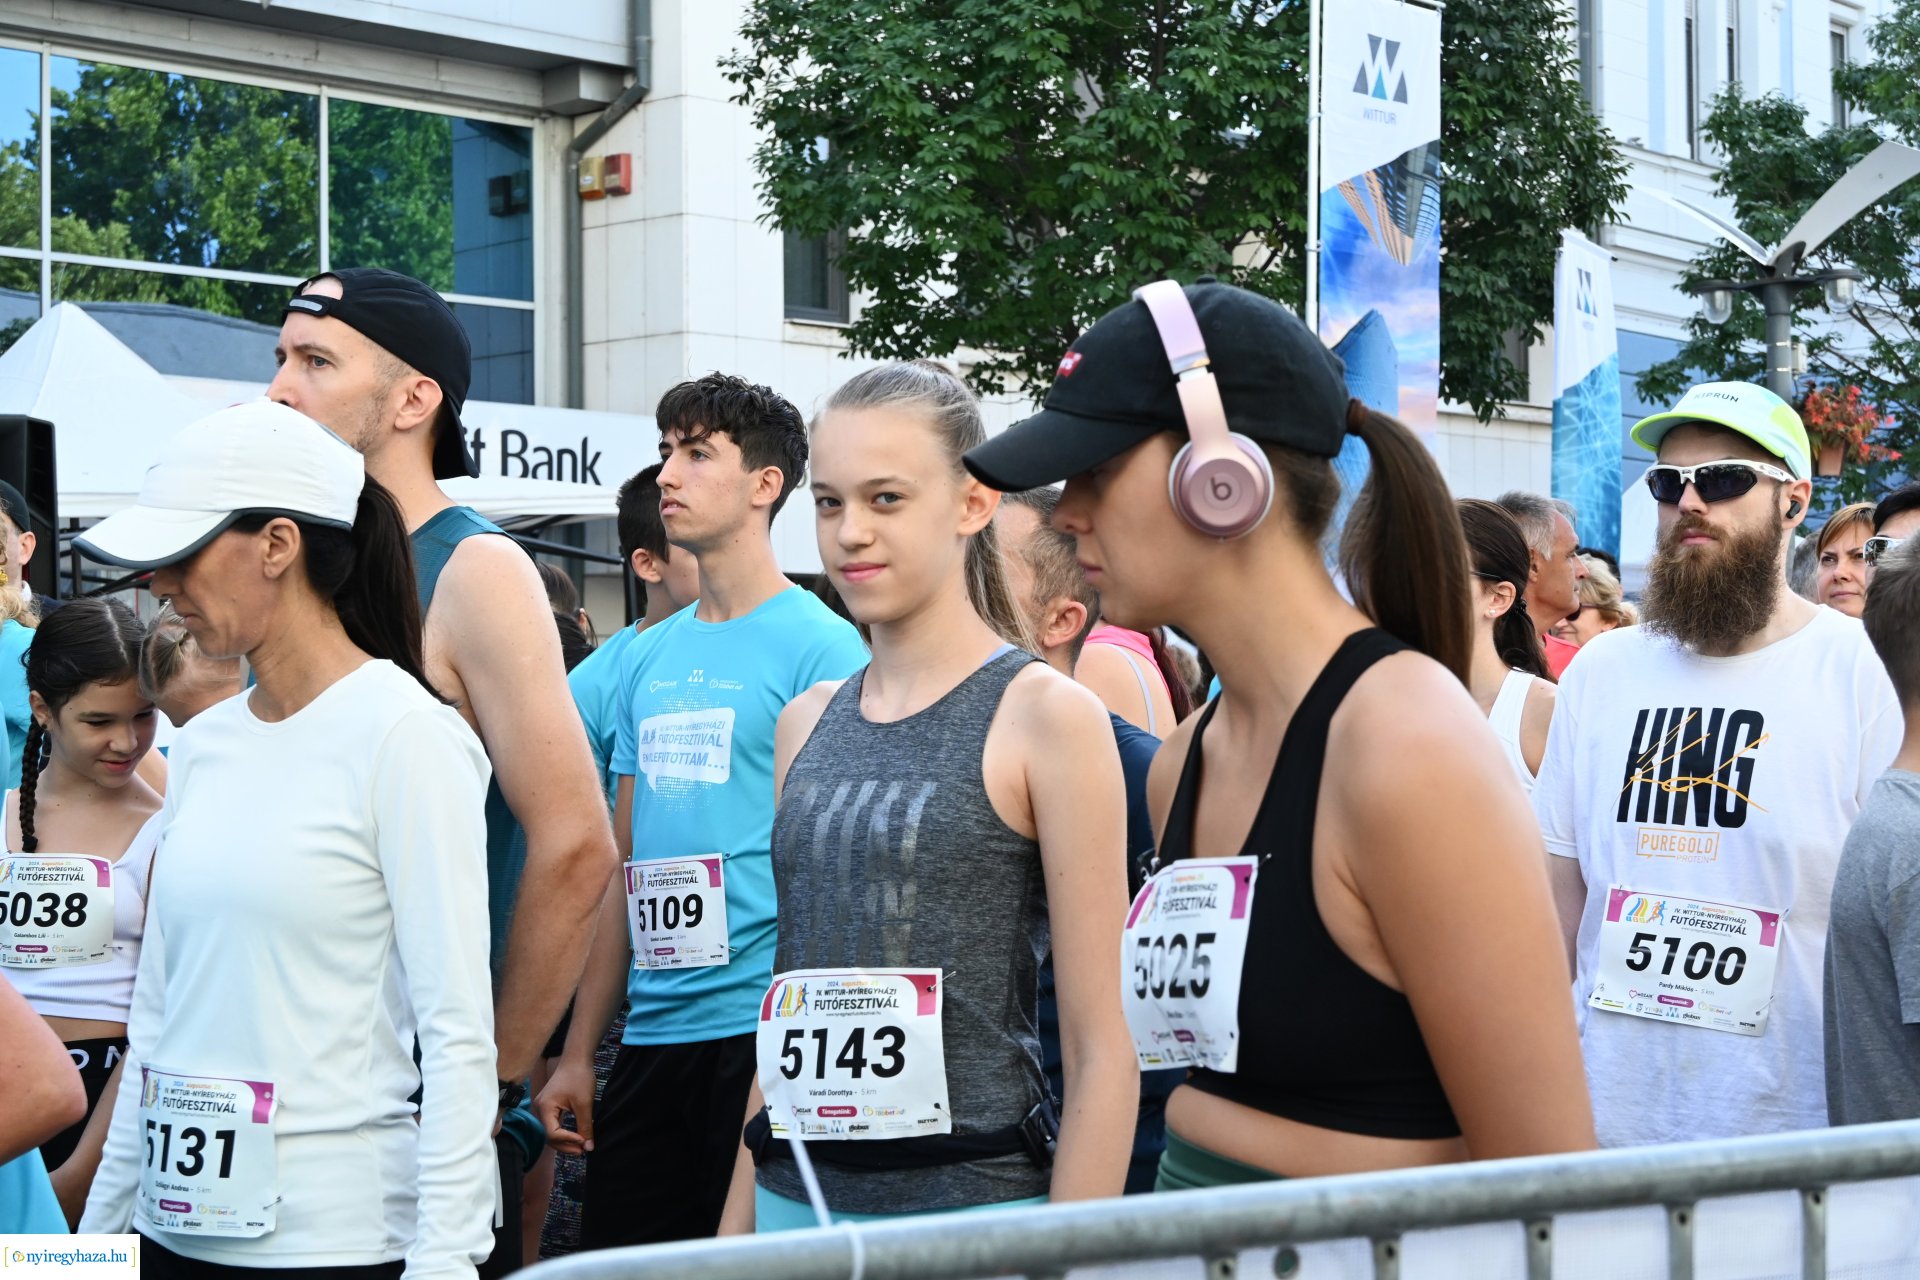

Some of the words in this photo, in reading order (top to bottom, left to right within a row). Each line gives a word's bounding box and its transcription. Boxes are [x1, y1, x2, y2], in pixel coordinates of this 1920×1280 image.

[1363, 108, 1397, 125] WITTUR
[501, 429, 602, 486] Bank
[1616, 707, 1765, 829] KING
[1641, 833, 1714, 854] PUREGOLD
[17, 871, 86, 882] FUTÓFESZTIVÁL
[647, 876, 699, 888] FUTÓFESZTIVÁL
[638, 893, 704, 932] 5109
[1683, 909, 1747, 925] WITTUR-NYÍREGYHÁZI
[1670, 915, 1748, 936] FUTÓFESZTIVÁL
[1134, 932, 1217, 1000] 5025
[1625, 932, 1748, 987] 5100
[824, 986, 897, 997] WITTUR-NYÍREGYHÁZI
[814, 996, 900, 1011] FUTÓFESZTIVÁL
[780, 1025, 906, 1080] 5143
[163, 1096, 238, 1114] FUTÓFESZTIVÁL
